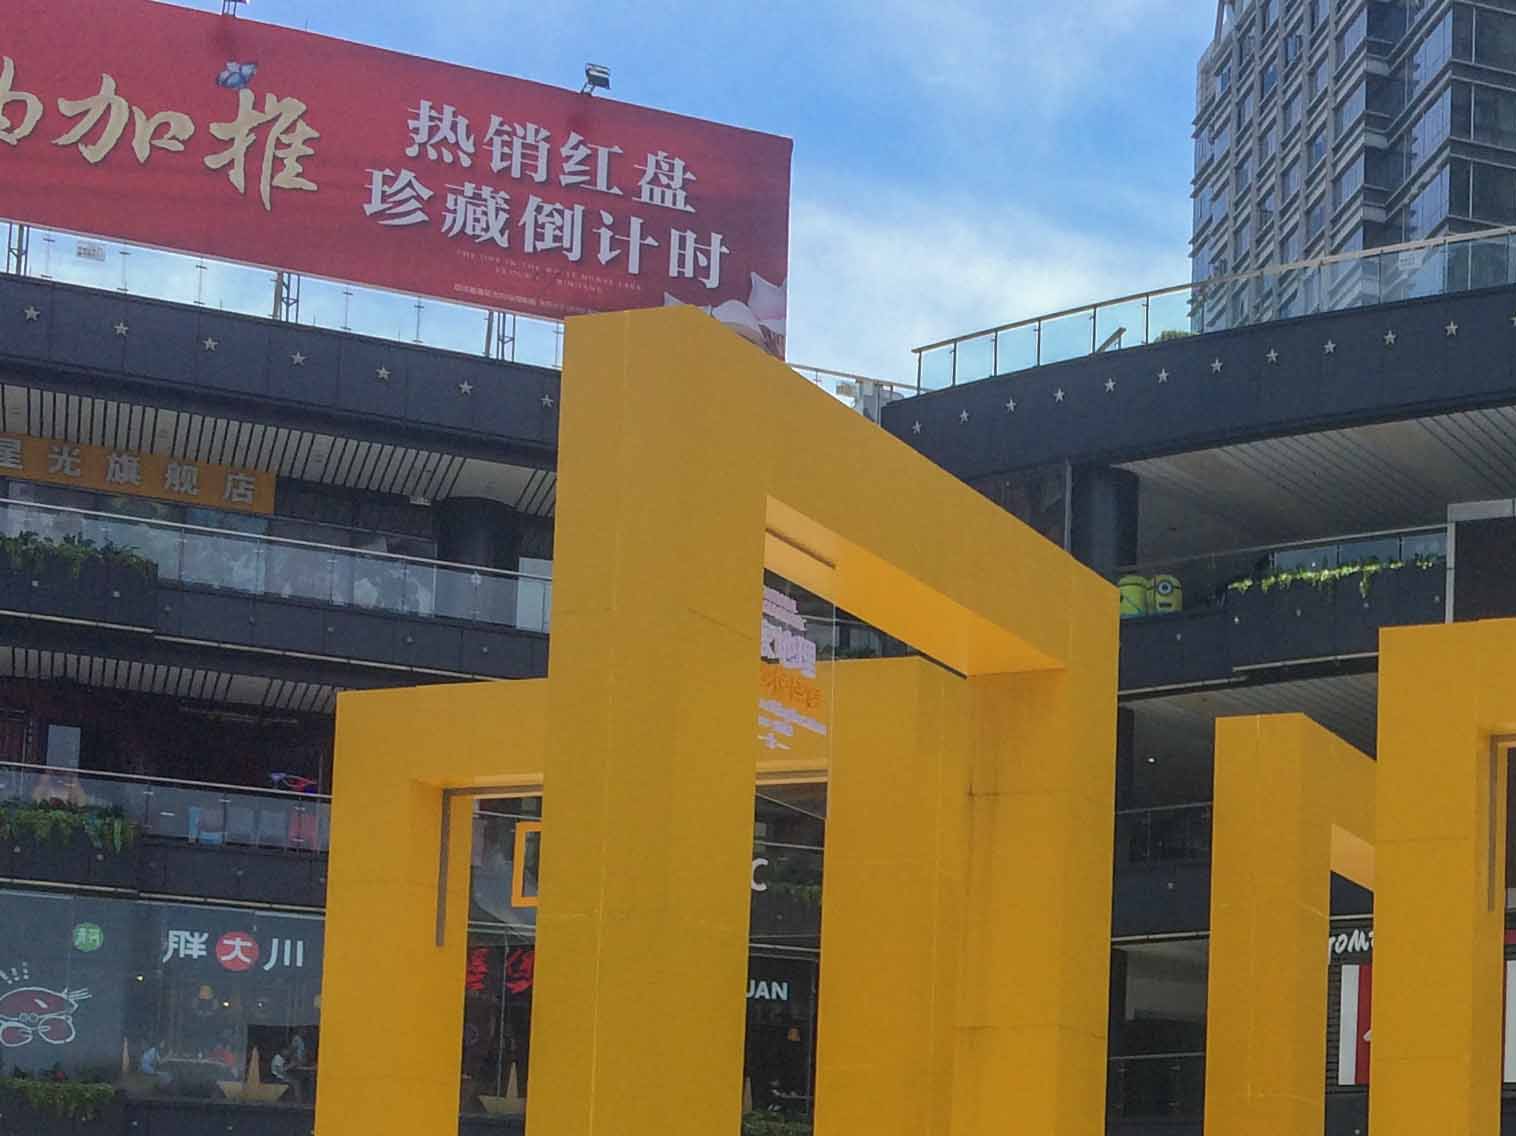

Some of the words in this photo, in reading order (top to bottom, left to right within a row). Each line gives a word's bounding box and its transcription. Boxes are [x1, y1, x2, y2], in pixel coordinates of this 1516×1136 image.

[404, 99, 696, 213] 热销红盘
[362, 167, 730, 289] 珍藏倒计时
[162, 929, 304, 971] 胖大川
